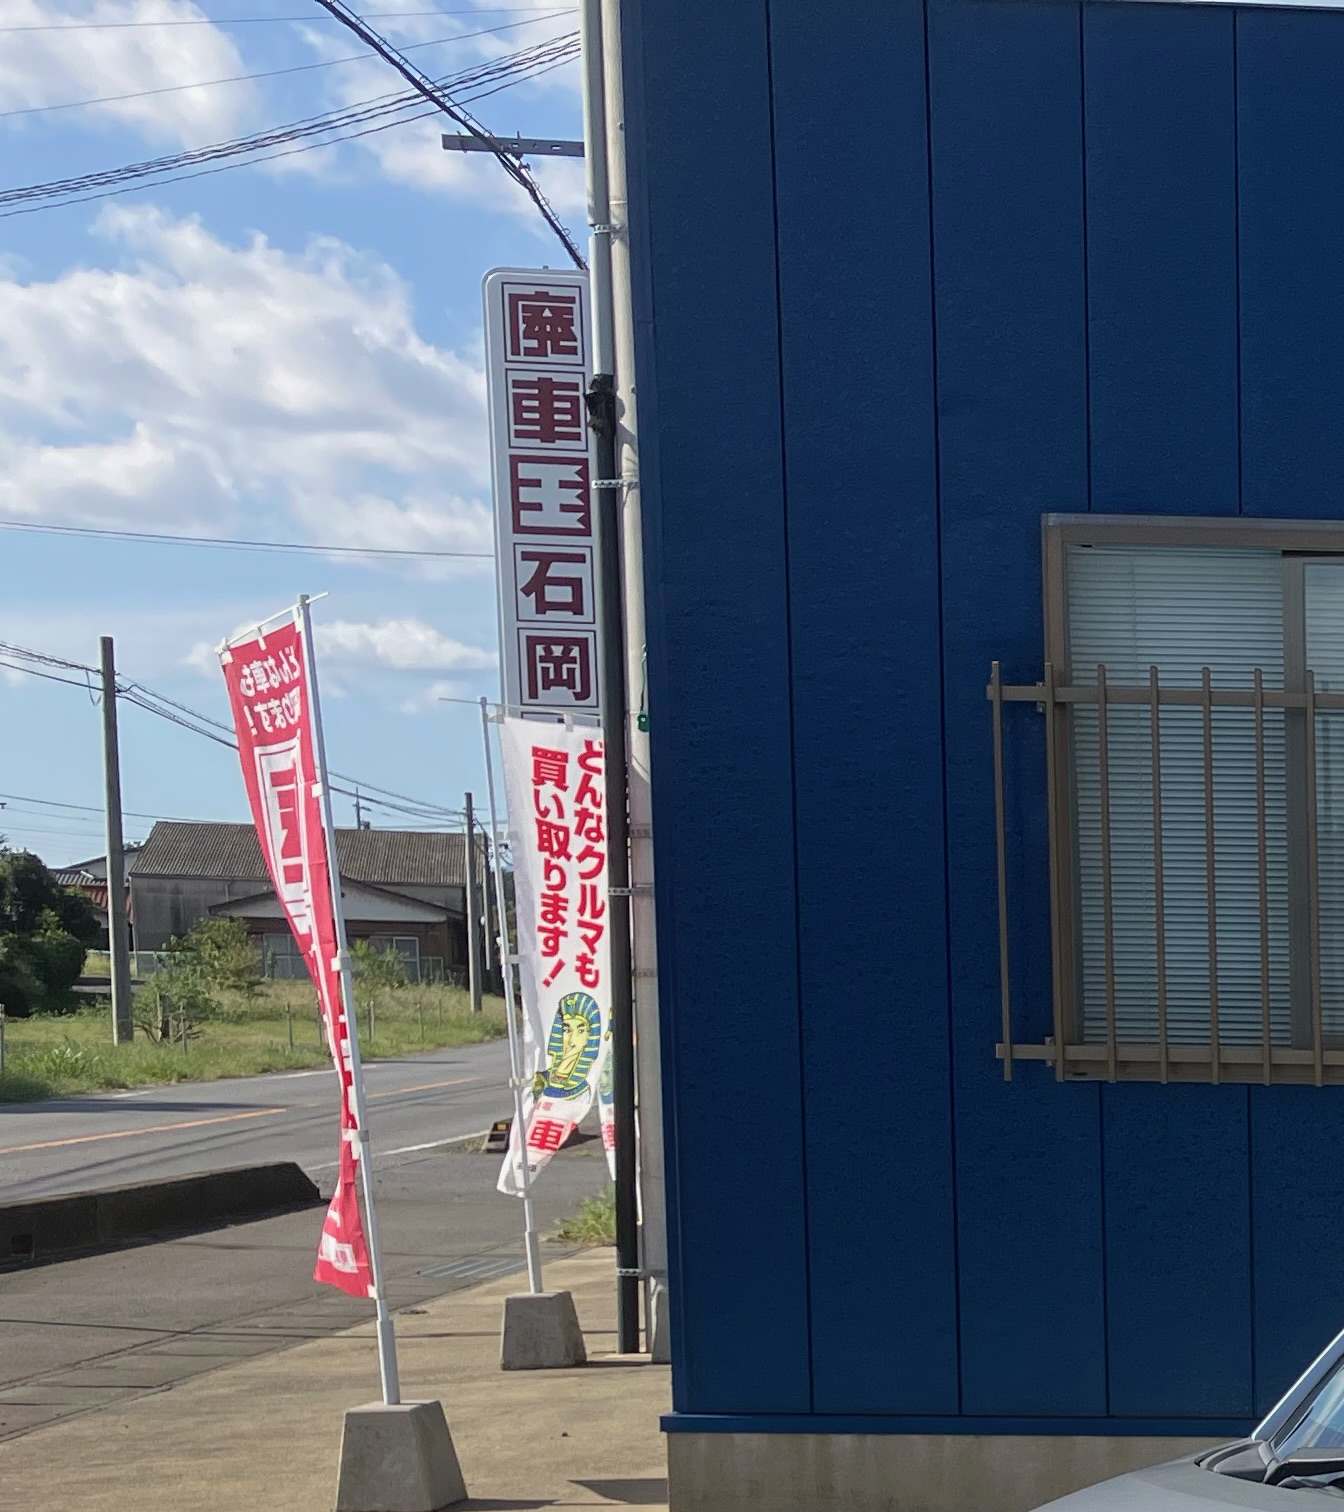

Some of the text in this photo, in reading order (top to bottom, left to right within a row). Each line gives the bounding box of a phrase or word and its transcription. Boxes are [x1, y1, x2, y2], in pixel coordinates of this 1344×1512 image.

[509, 290, 592, 703] 廃車王石岡
[573, 738, 606, 989] どんなクルマも
